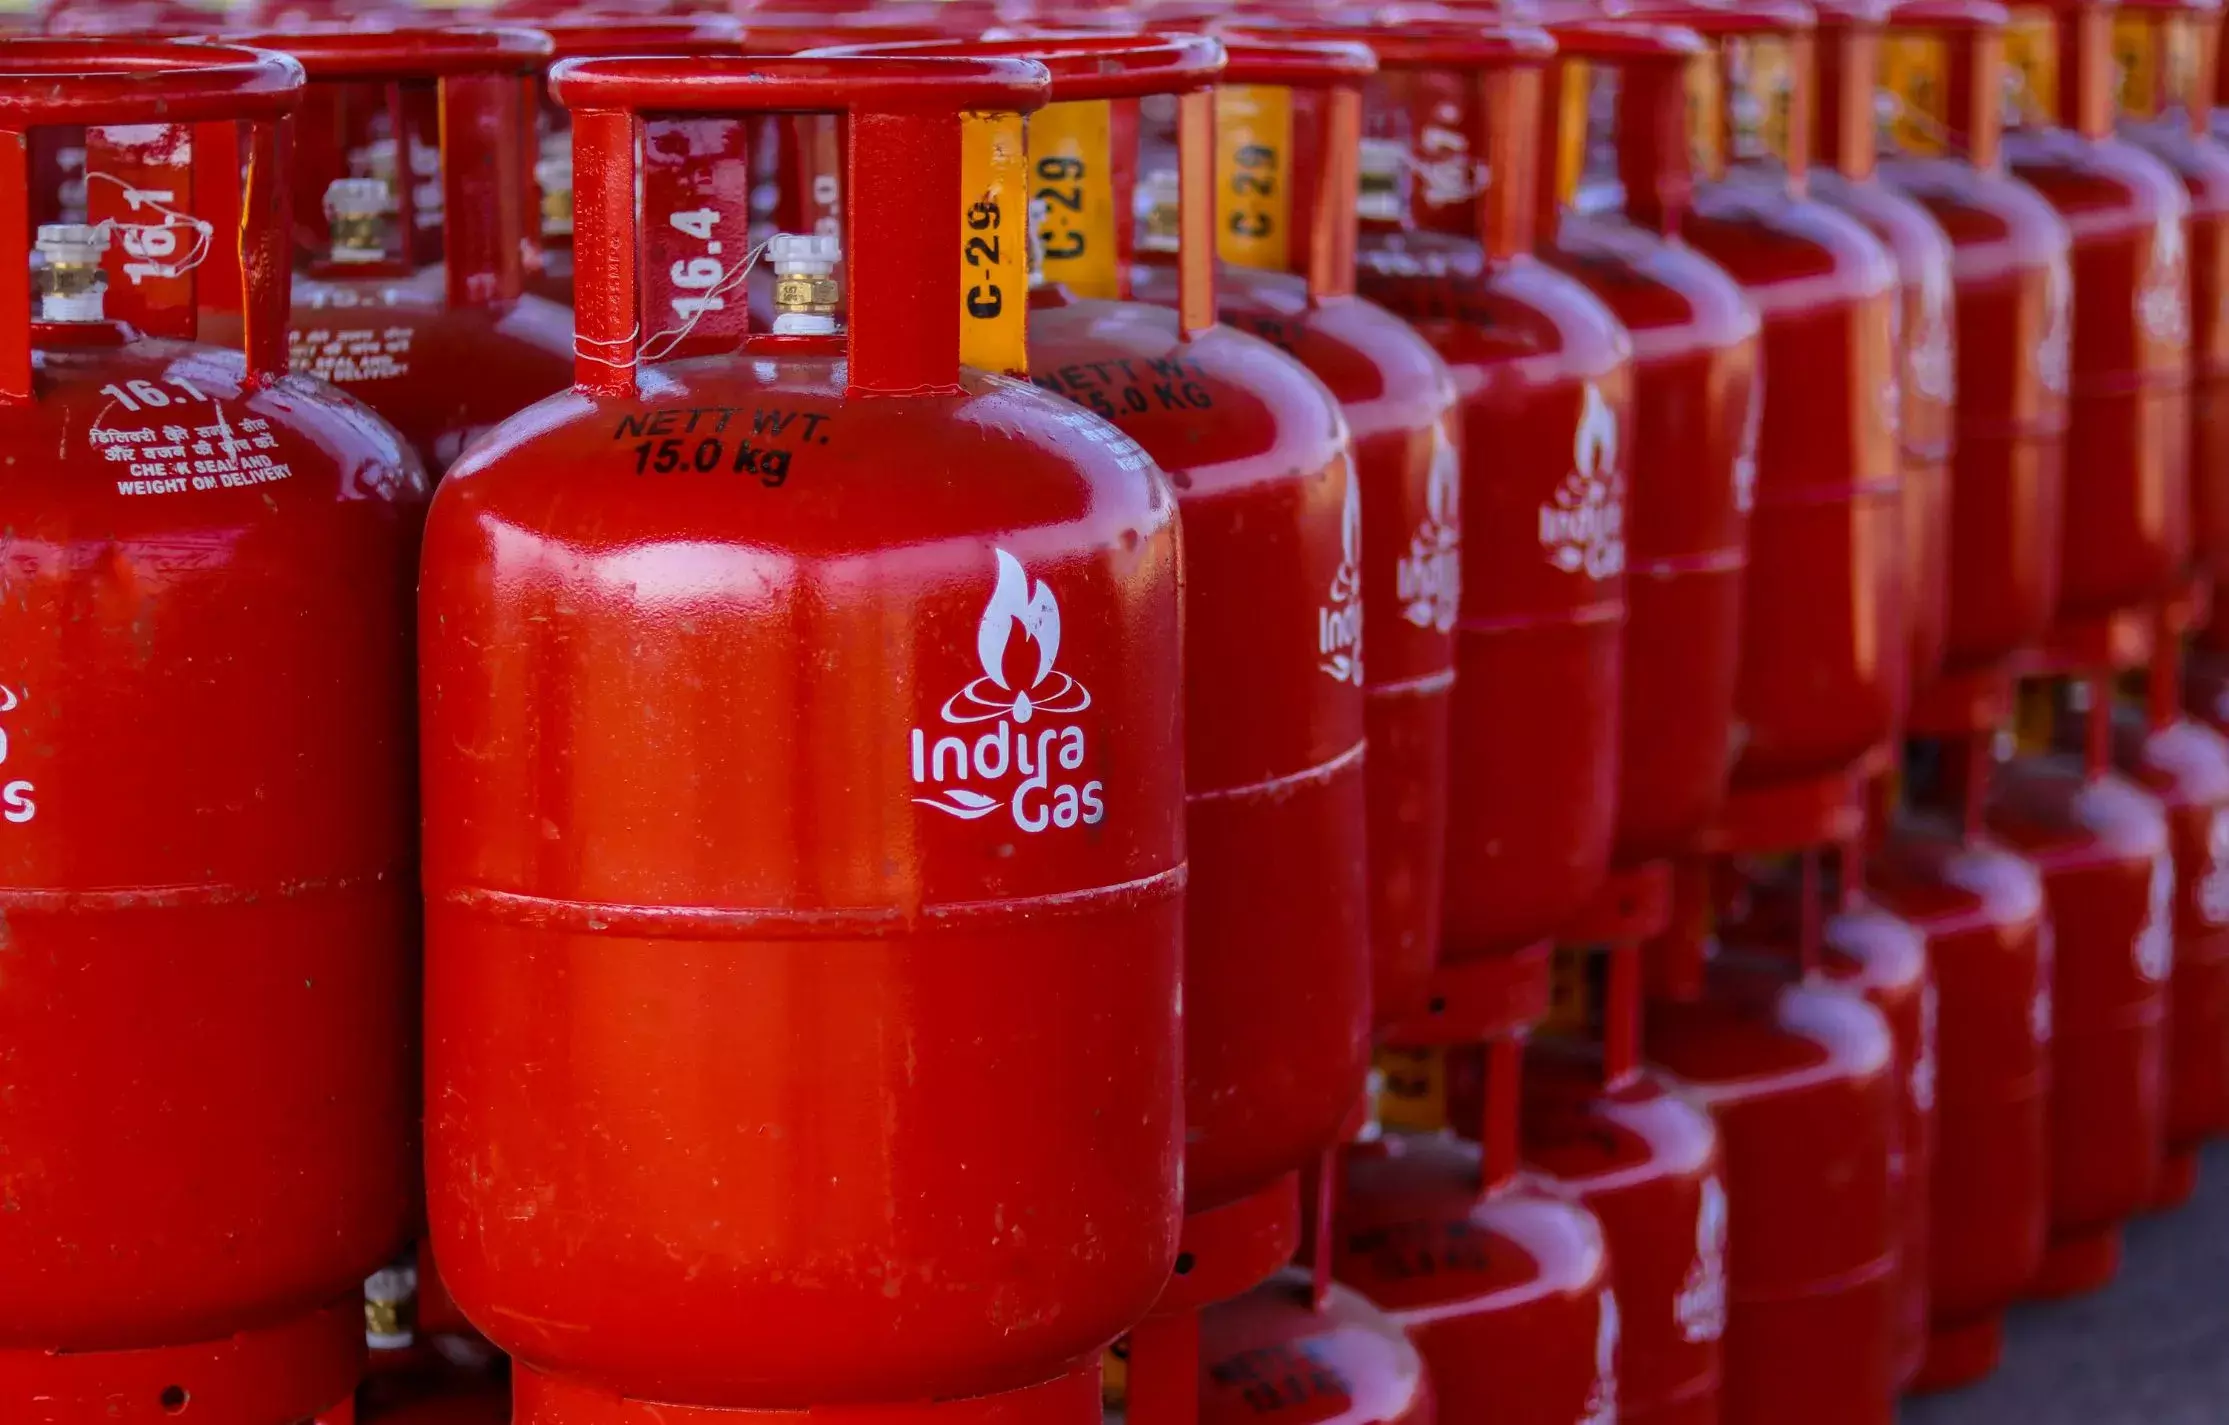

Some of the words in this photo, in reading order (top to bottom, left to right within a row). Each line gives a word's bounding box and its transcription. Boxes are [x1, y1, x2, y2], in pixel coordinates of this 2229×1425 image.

[1036, 156, 1086, 260] C-29
[122, 189, 176, 284] 16.1
[965, 200, 1002, 319] C-29
[670, 207, 724, 320] 16.4
[100, 375, 207, 411] 16.1
[1068, 386, 1149, 419] 5.0
[1153, 380, 1213, 410] KG
[613, 408, 744, 440] NETT
[752, 407, 832, 446] WT.
[117, 477, 188, 496] WEIGHT
[192, 475, 219, 491] ON
[220, 463, 293, 488] DELIVERY
[130, 461, 191, 477] CHEK
[193, 458, 239, 474] SEAL
[240, 454, 273, 470] AND
[634, 437, 724, 476] 15.0
[732, 438, 793, 488] kg
[911, 719, 1085, 786] Indira
[1011, 778, 1104, 833] Gas
